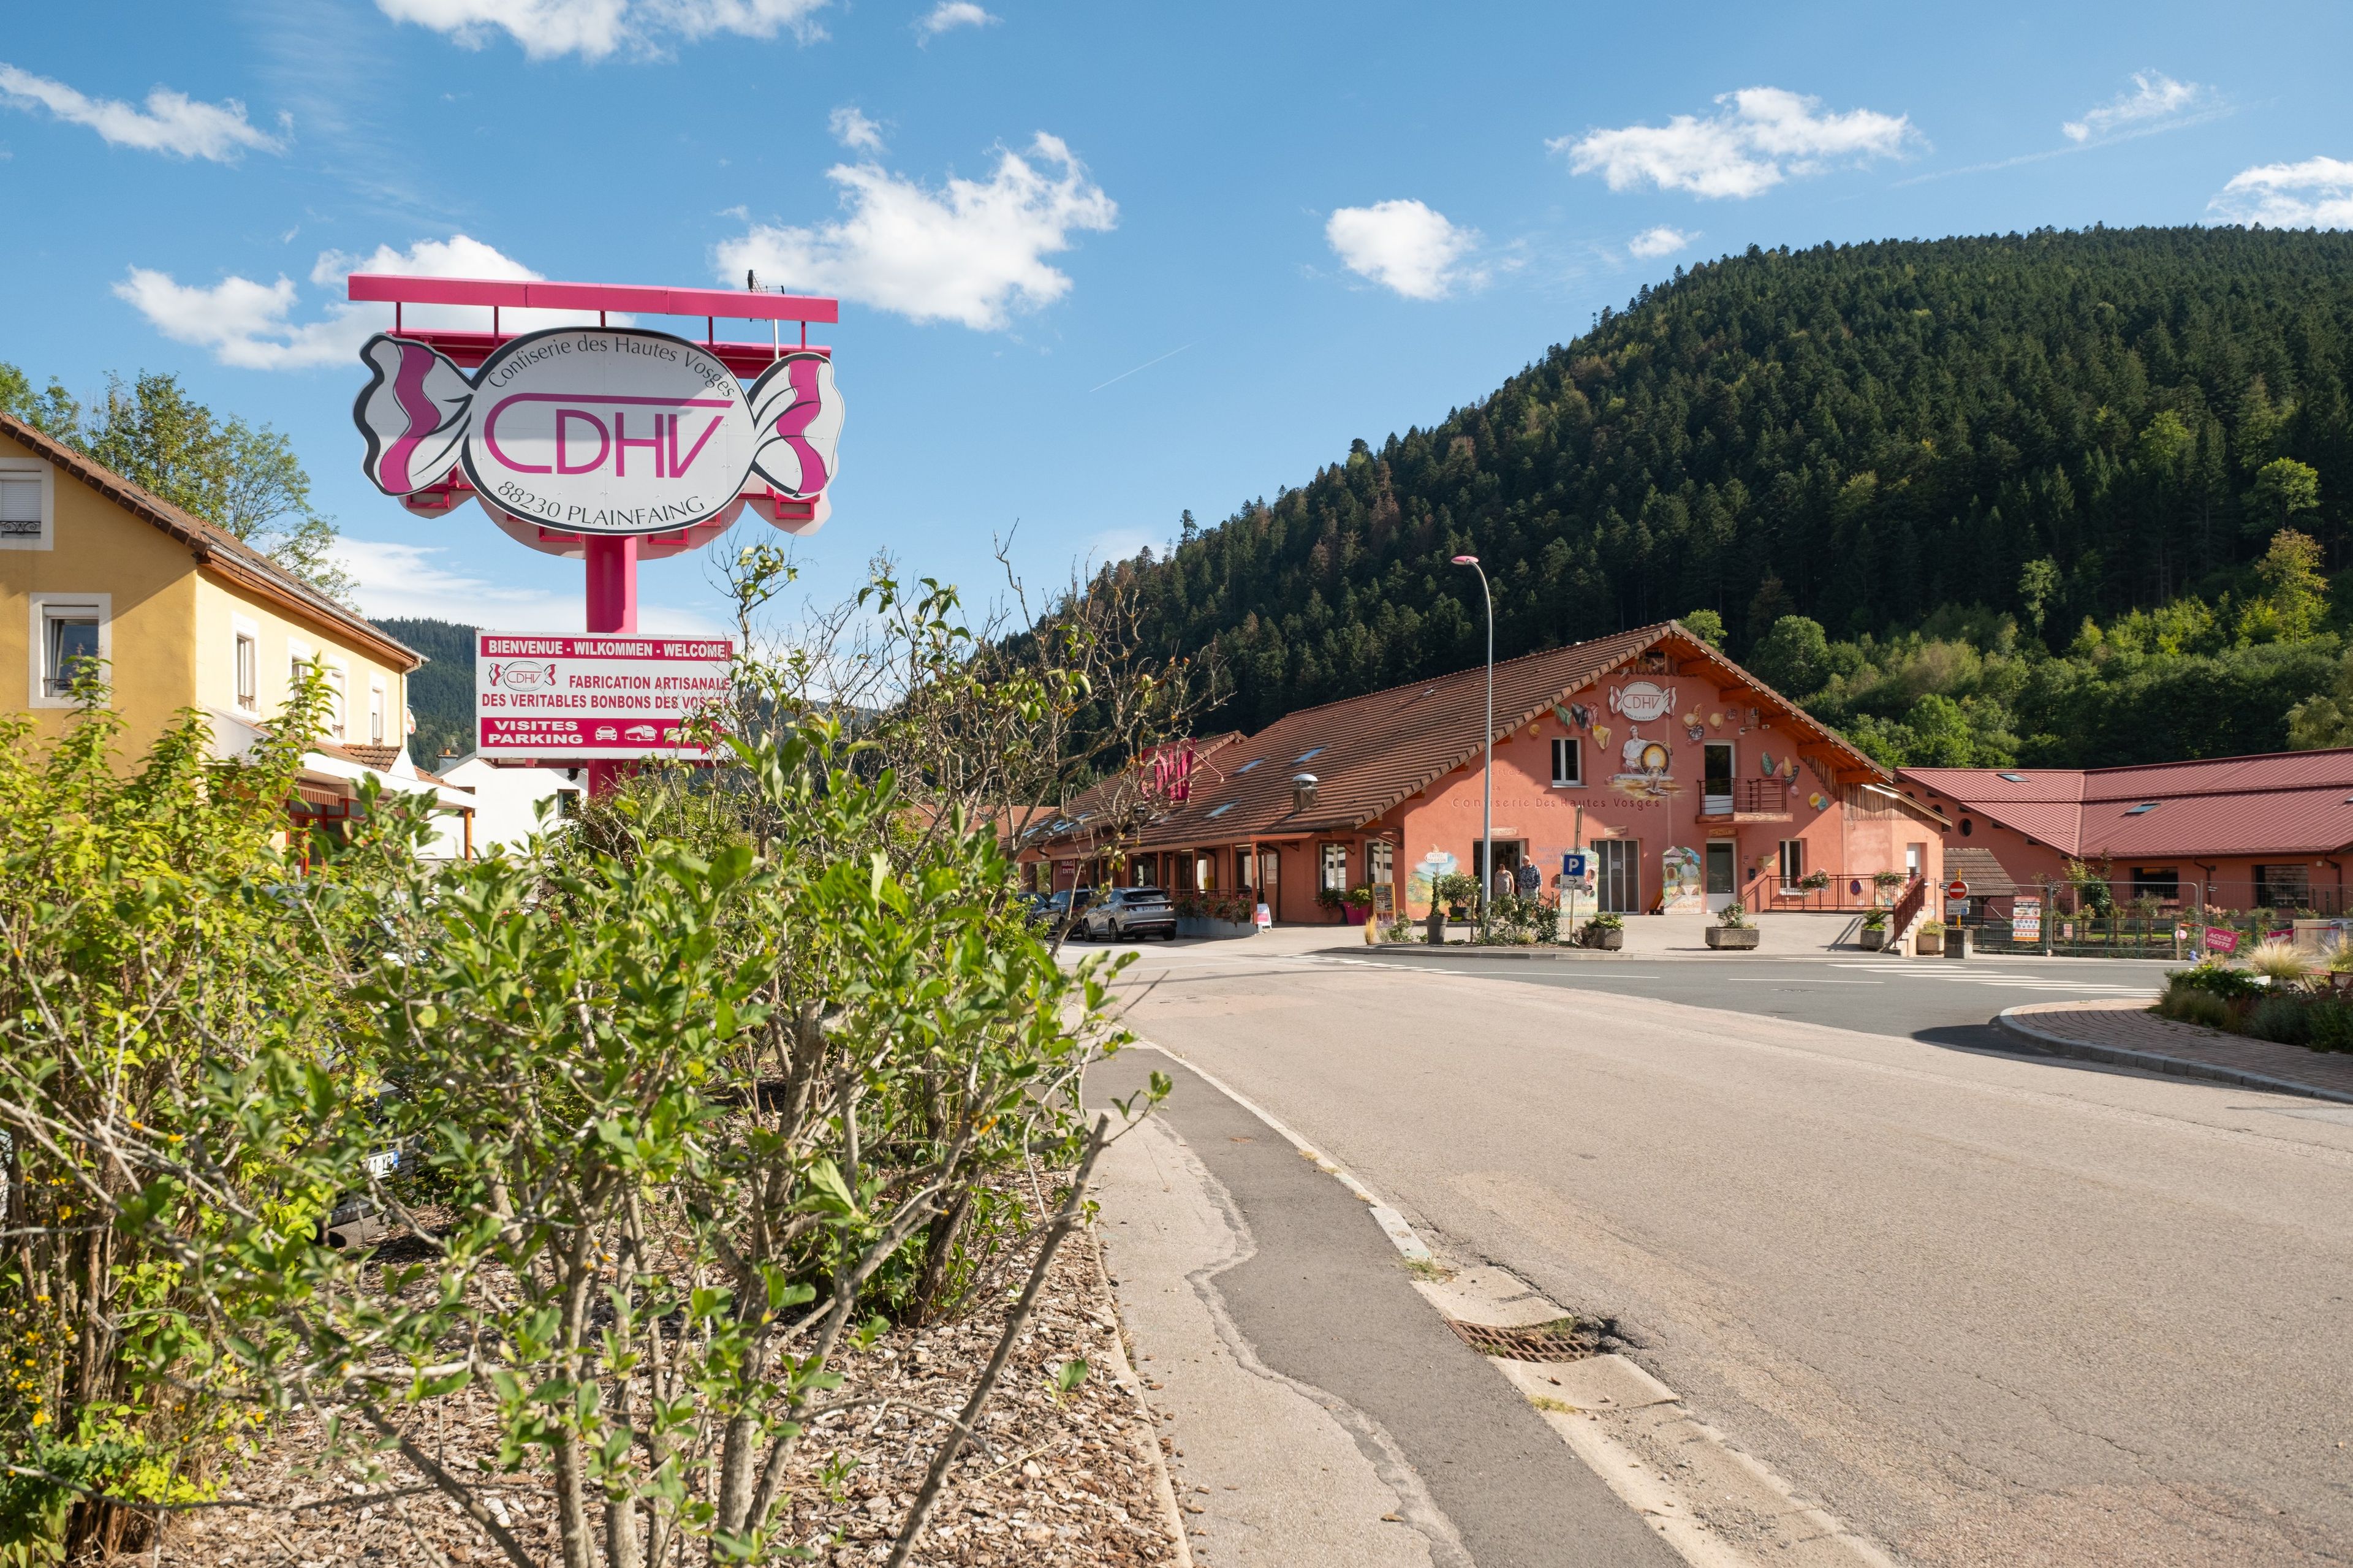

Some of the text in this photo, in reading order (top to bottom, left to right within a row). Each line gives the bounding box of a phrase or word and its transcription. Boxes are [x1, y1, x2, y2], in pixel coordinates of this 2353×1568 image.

[487, 334, 736, 398] Confiserie des Hautes Vosges
[483, 392, 735, 479] CDHV
[498, 481, 706, 526] 88230 PLAINFAING
[488, 640, 563, 655] BIENVENUE
[574, 642, 653, 657] WILKOMMEN
[663, 643, 726, 657] WELCOME
[507, 670, 542, 683] CDHV
[569, 675, 731, 691] FABRICATION ARTISANALE
[482, 693, 506, 707] DES
[511, 694, 587, 708] VERITABLES
[591, 695, 651, 710] BONBONS
[655, 696, 678, 709] DES
[1623, 694, 1661, 709] CDHV
[494, 721, 578, 732] VISITES
[488, 733, 583, 744] PARKING
[1476, 768, 1523, 776] Vsitez
[1452, 798, 1660, 811] Coniserie Des Hautes Vosges
[1569, 858, 1579, 873] P
[2207, 937, 2231, 948] VISITE
